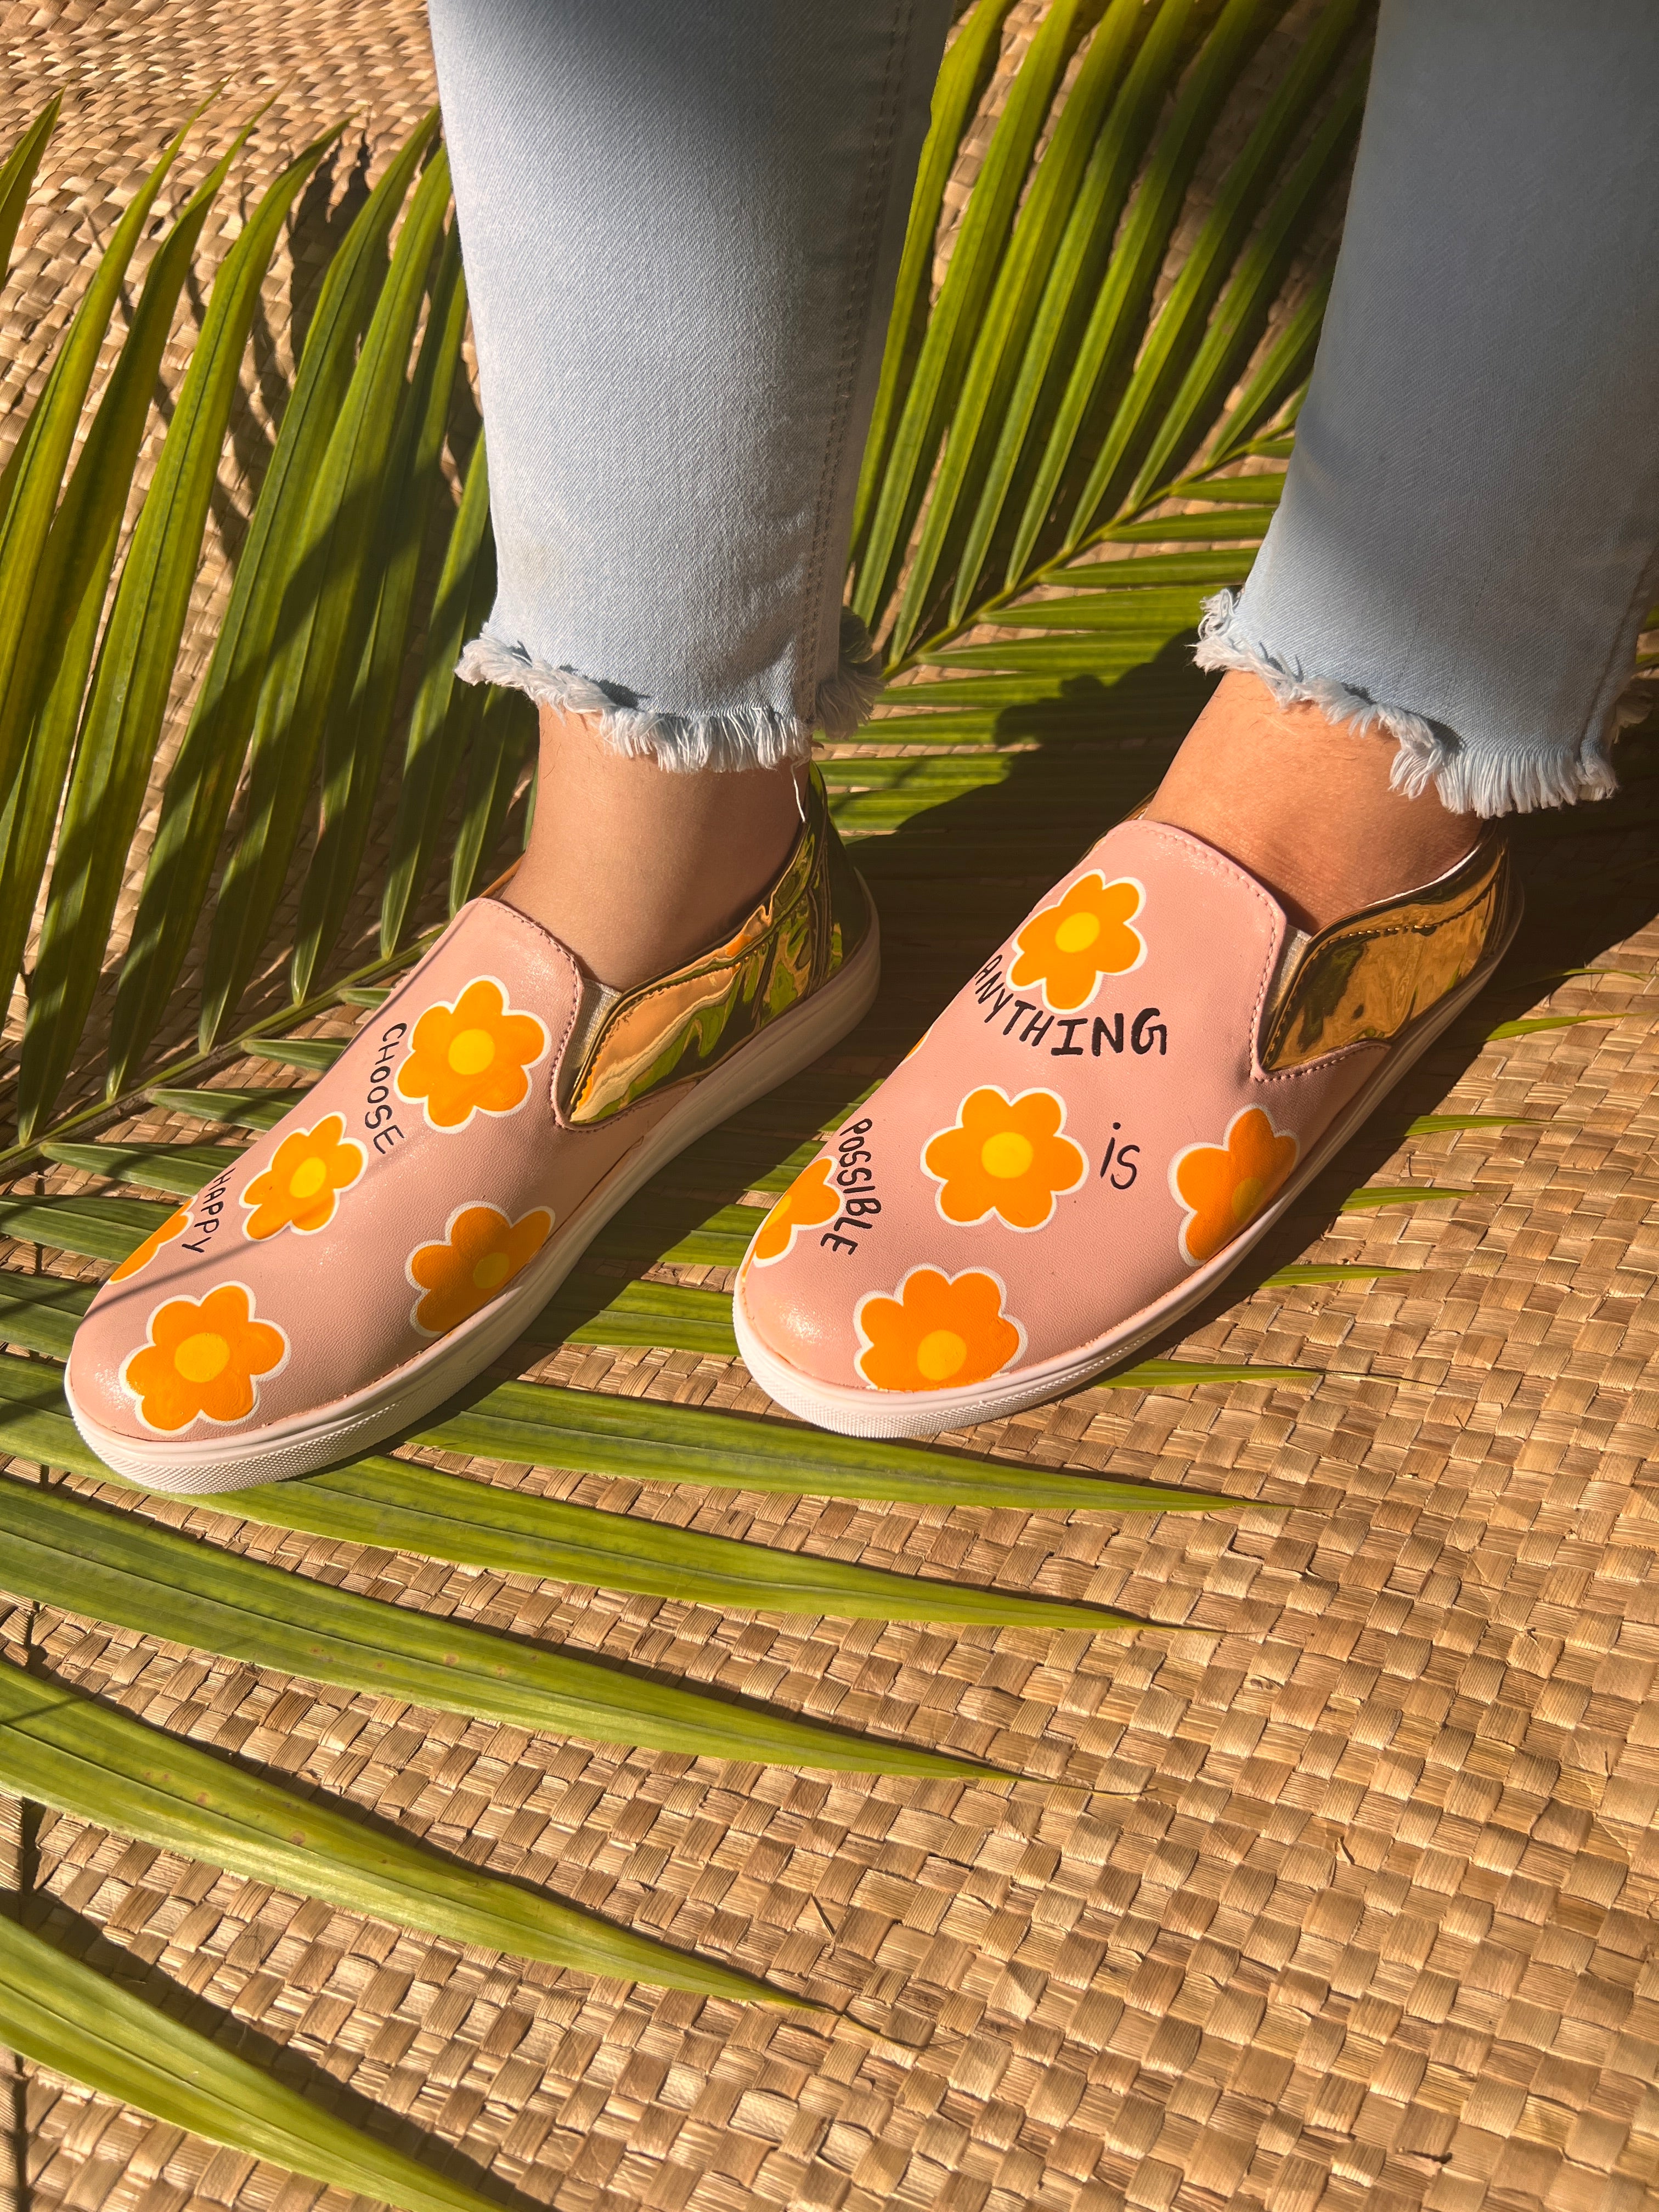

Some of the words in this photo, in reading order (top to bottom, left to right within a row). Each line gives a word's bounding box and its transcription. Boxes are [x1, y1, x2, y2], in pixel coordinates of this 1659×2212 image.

[975, 954, 1167, 1057] ANYTHING
[365, 1023, 407, 1154] CHOOSE
[182, 1167, 236, 1253] HAPPY
[820, 1118, 882, 1255] POSSIBLE
